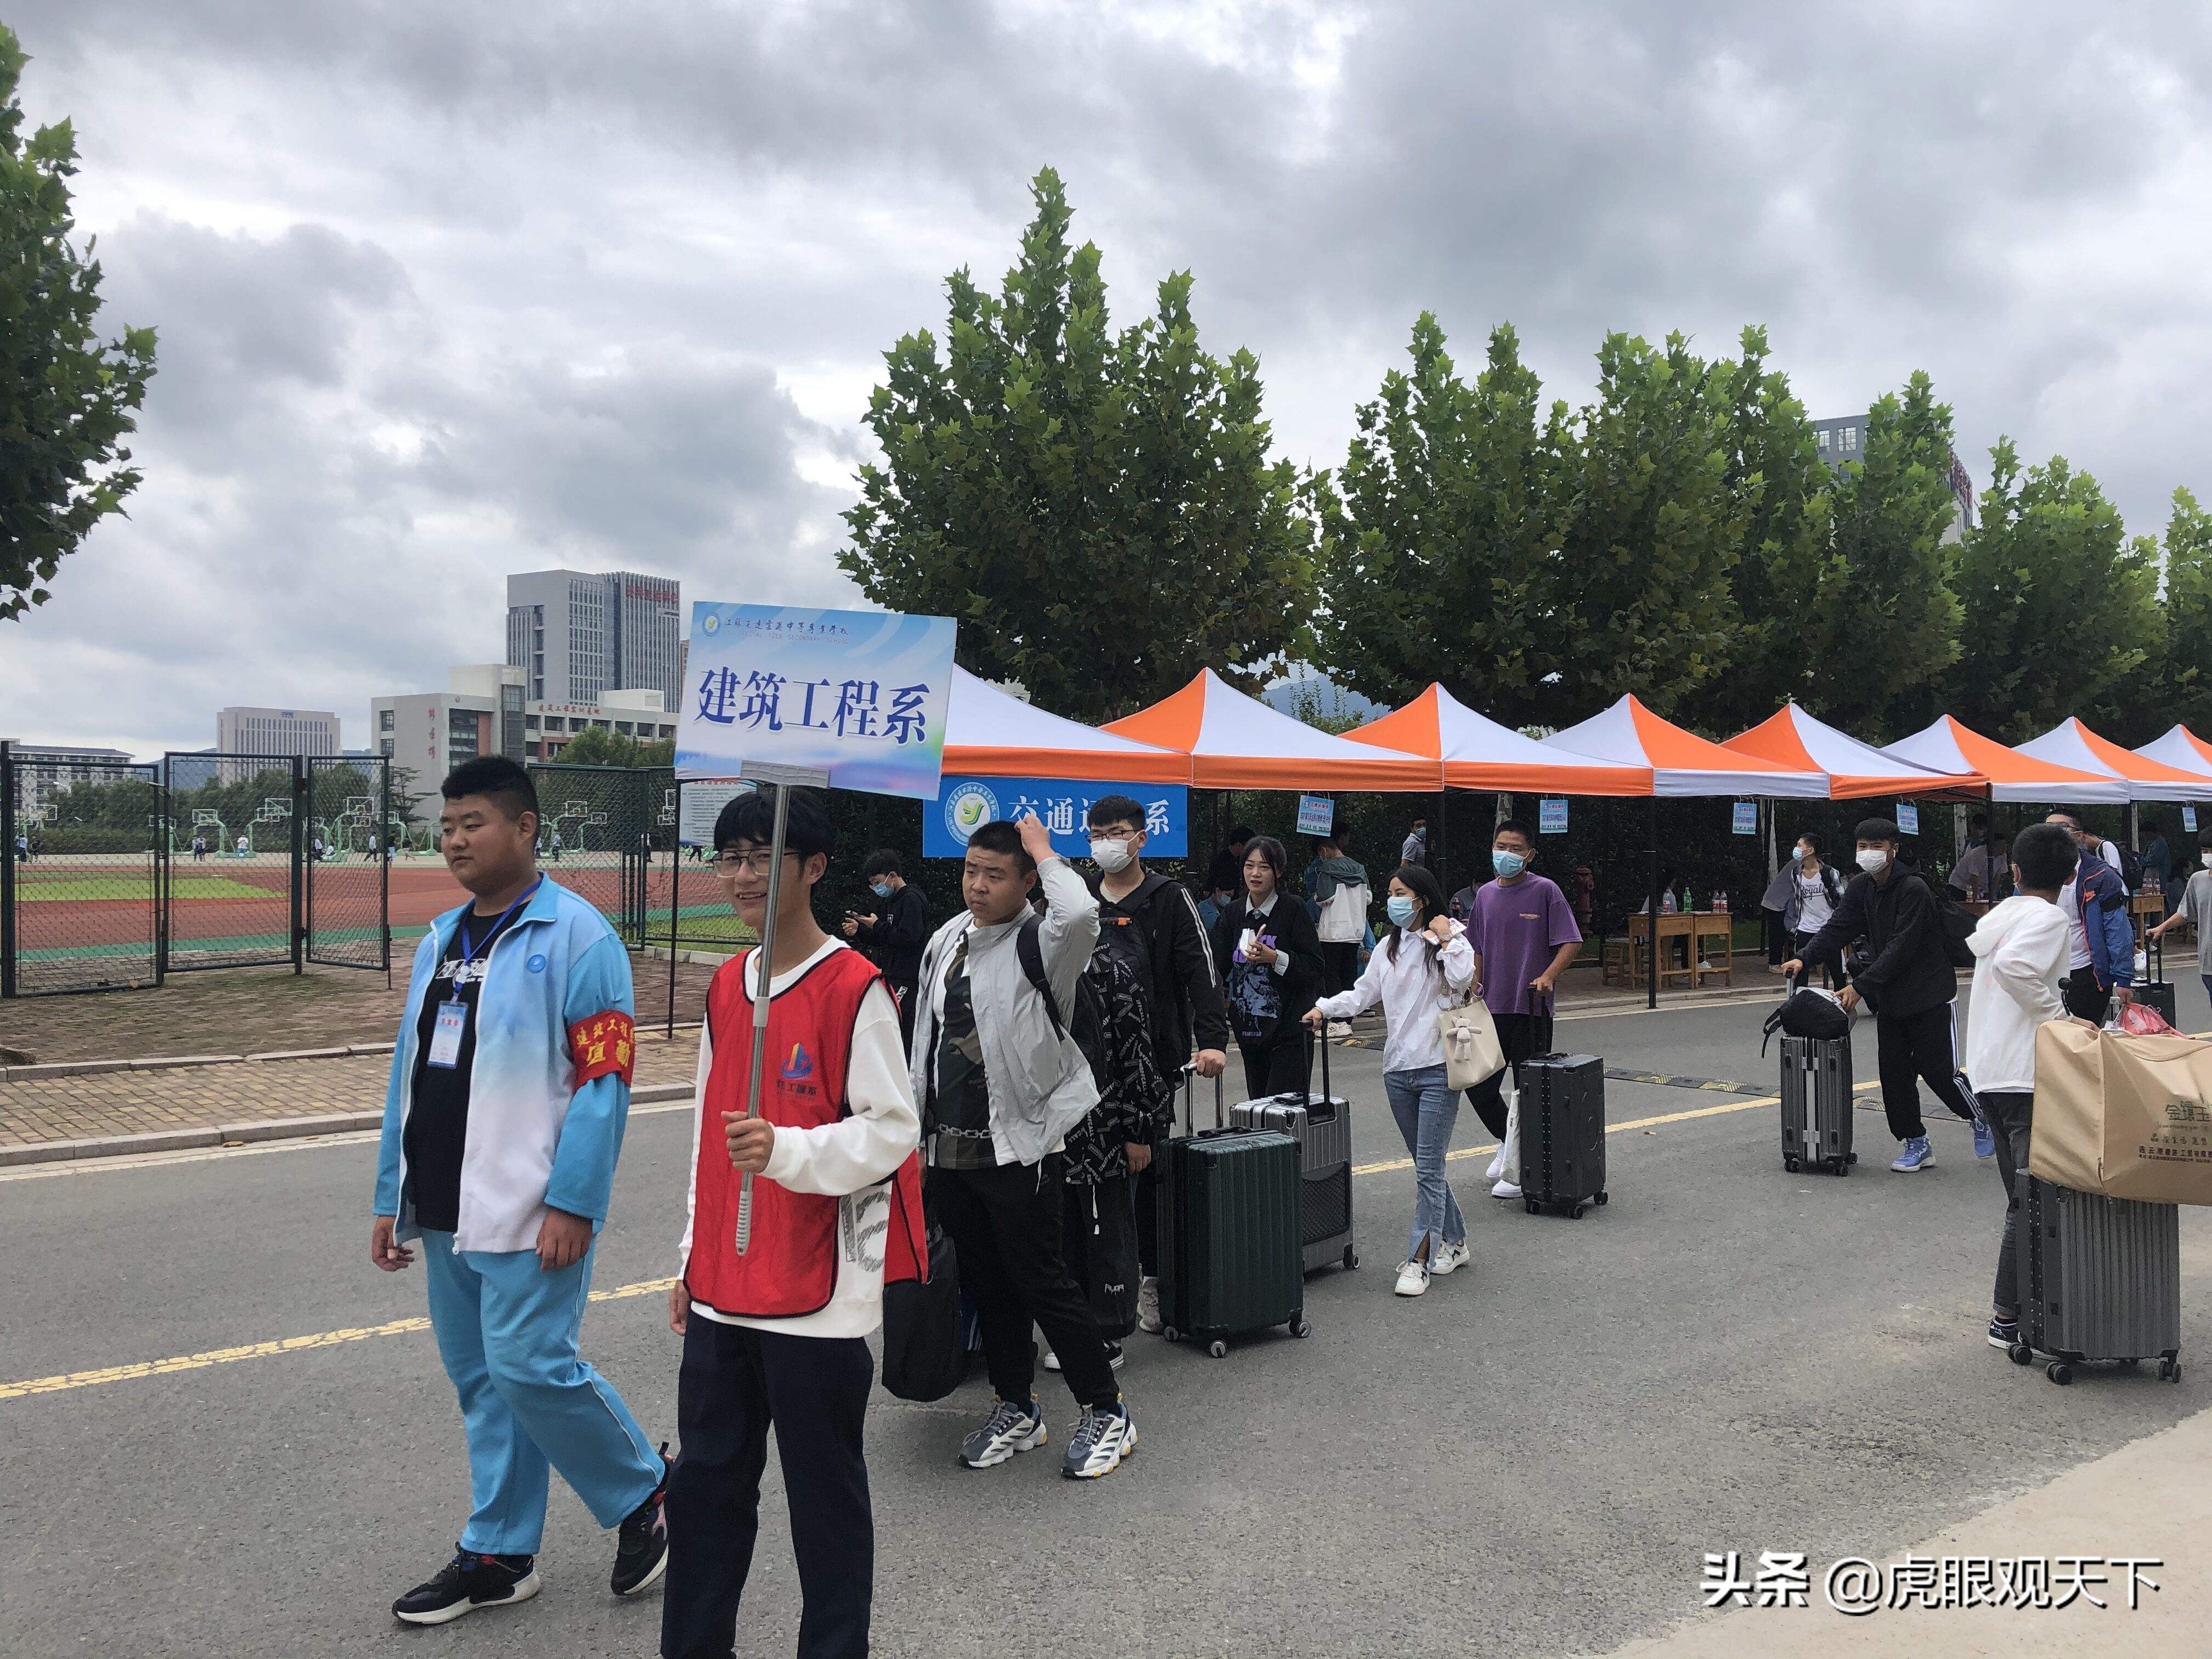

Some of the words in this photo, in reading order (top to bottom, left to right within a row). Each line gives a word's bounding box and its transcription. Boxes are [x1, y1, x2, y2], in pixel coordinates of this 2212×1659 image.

[693, 665, 930, 744] 建筑工程系
[1008, 795, 1170, 836] 交通系
